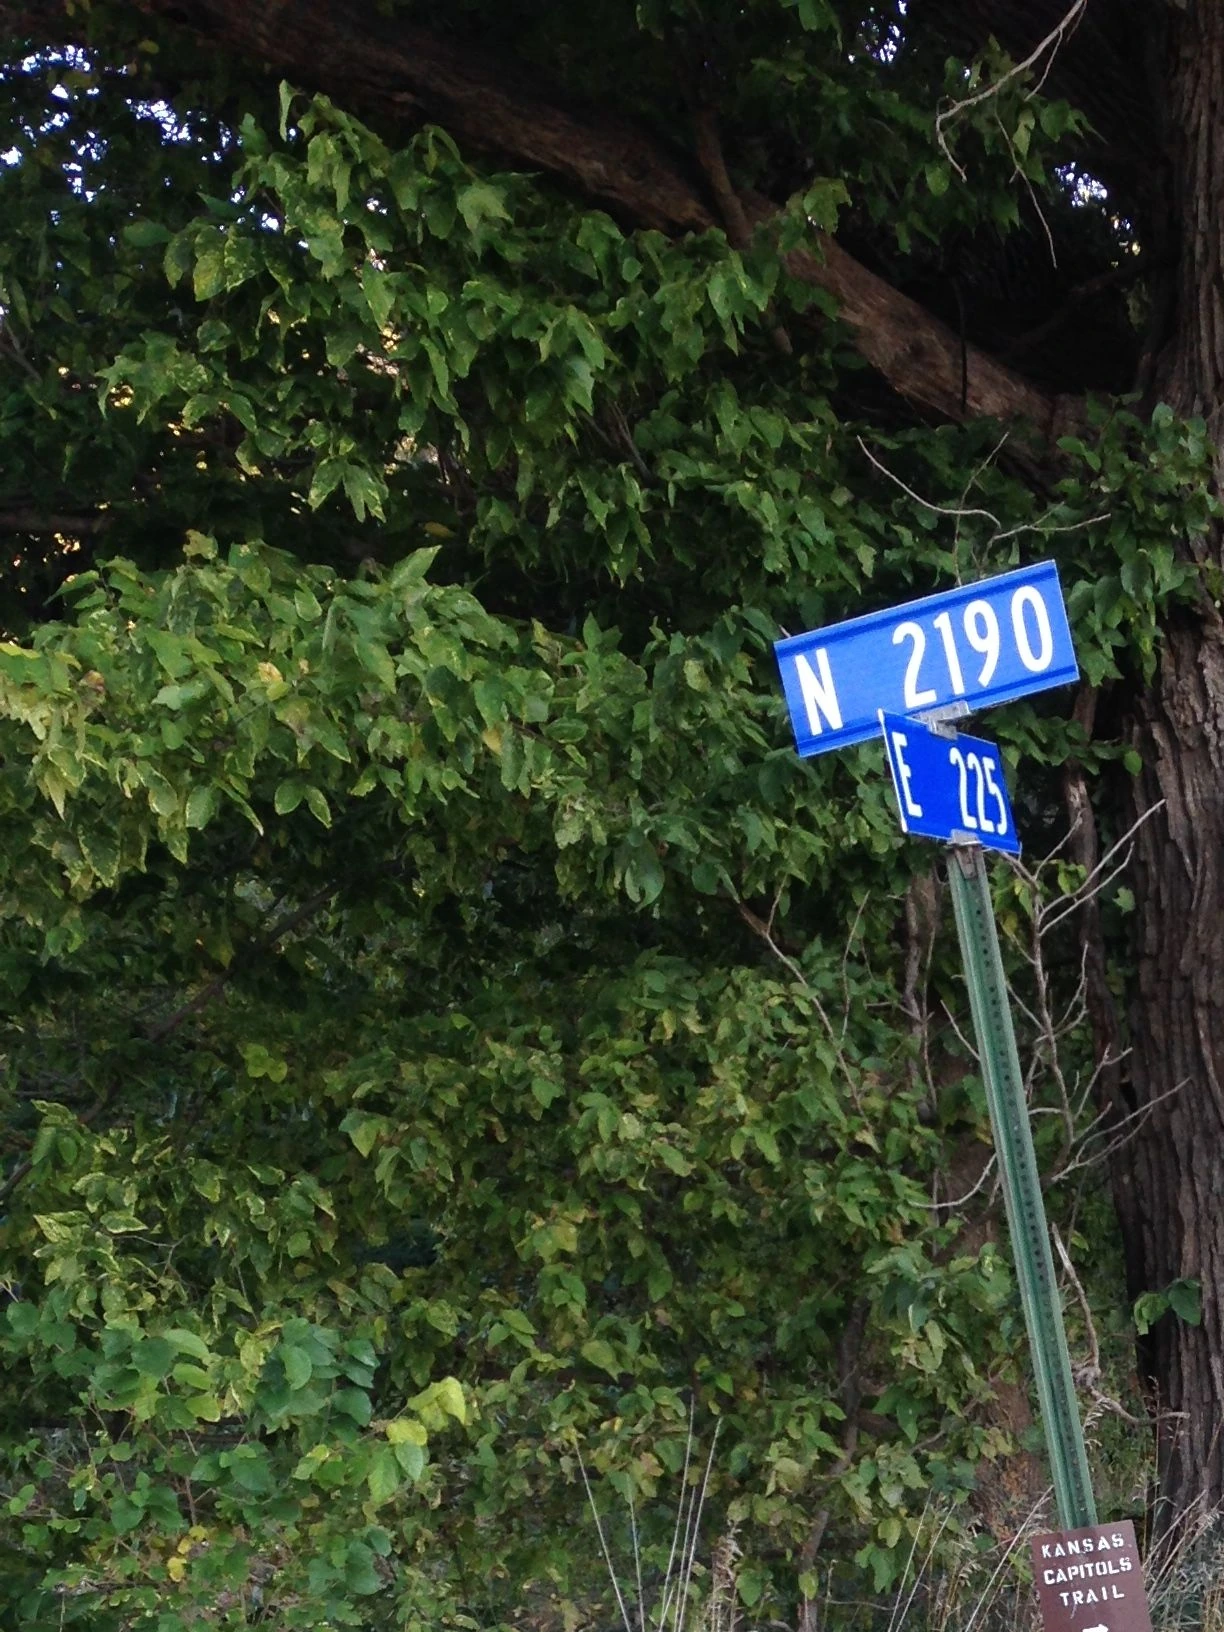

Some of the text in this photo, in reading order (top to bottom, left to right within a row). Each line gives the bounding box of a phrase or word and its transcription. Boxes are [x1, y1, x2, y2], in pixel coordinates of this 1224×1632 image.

[794, 585, 1054, 736] N 2190
[891, 732, 1008, 836] E 225
[1041, 1532, 1125, 1559] KANSAS
[1043, 1556, 1133, 1585] CAPITOLS
[1059, 1584, 1125, 1607] TRAIL
